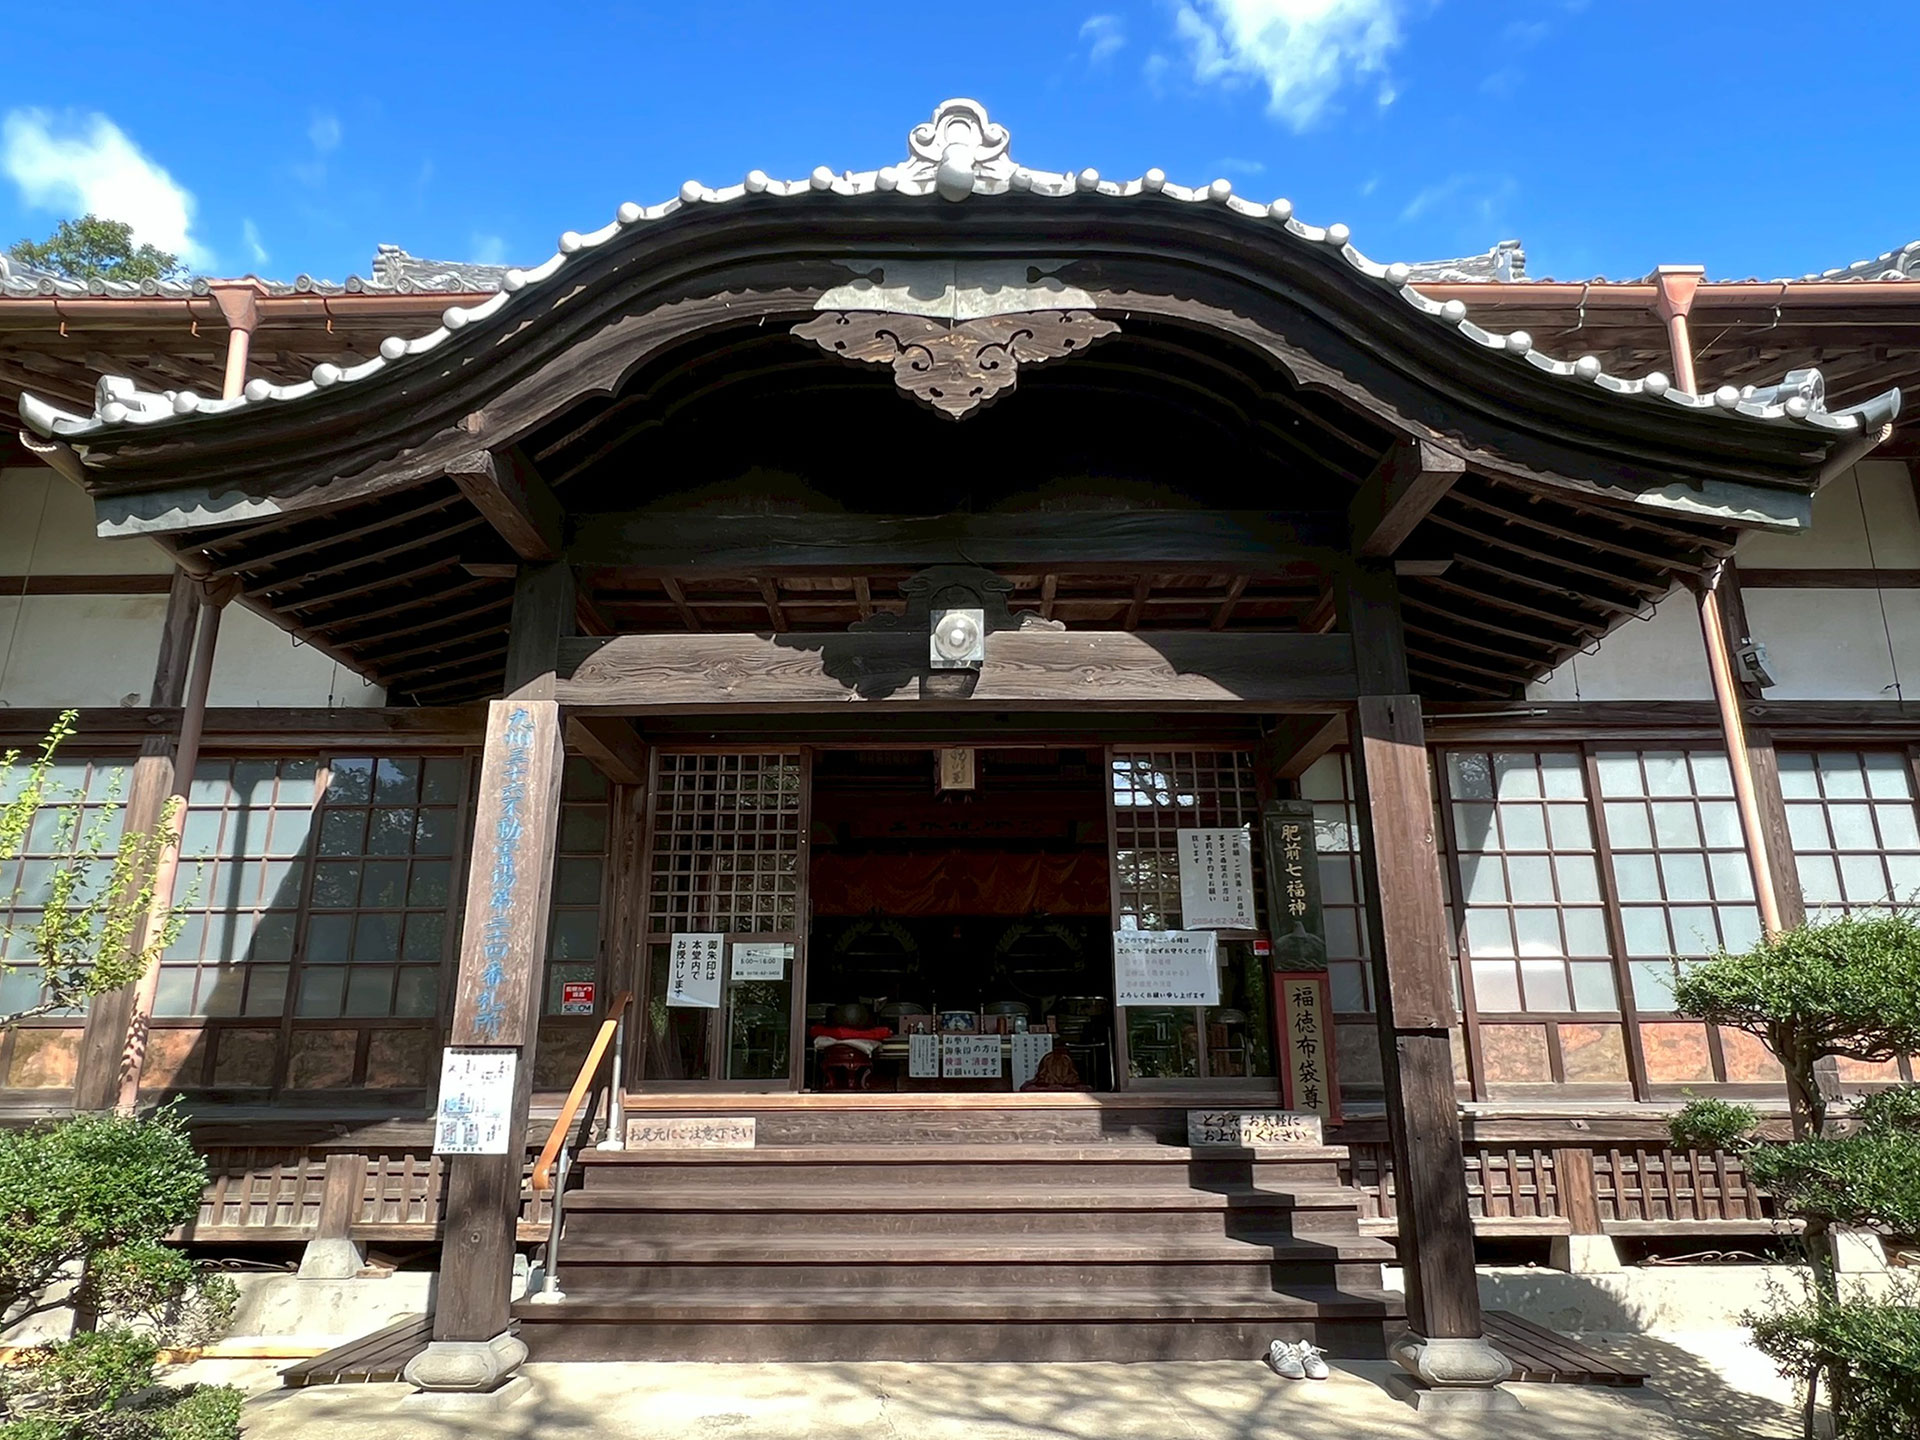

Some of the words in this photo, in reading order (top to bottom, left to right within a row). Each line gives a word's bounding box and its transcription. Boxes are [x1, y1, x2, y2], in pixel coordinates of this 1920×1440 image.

[1281, 824, 1307, 916] 肥前七福神
[674, 940, 686, 997] お授けします
[691, 940, 702, 980] 本堂内で
[706, 940, 718, 980] 御朱印は
[1119, 991, 1206, 999] よろしくお願い申し上げます
[1293, 987, 1323, 1109] 福徳布袋尊
[946, 1068, 999, 1076] お願いします
[629, 1125, 753, 1142] お足元にご注意下さい
[1204, 1130, 1307, 1142] お上がりください
[1248, 1115, 1301, 1130] お気軽に
